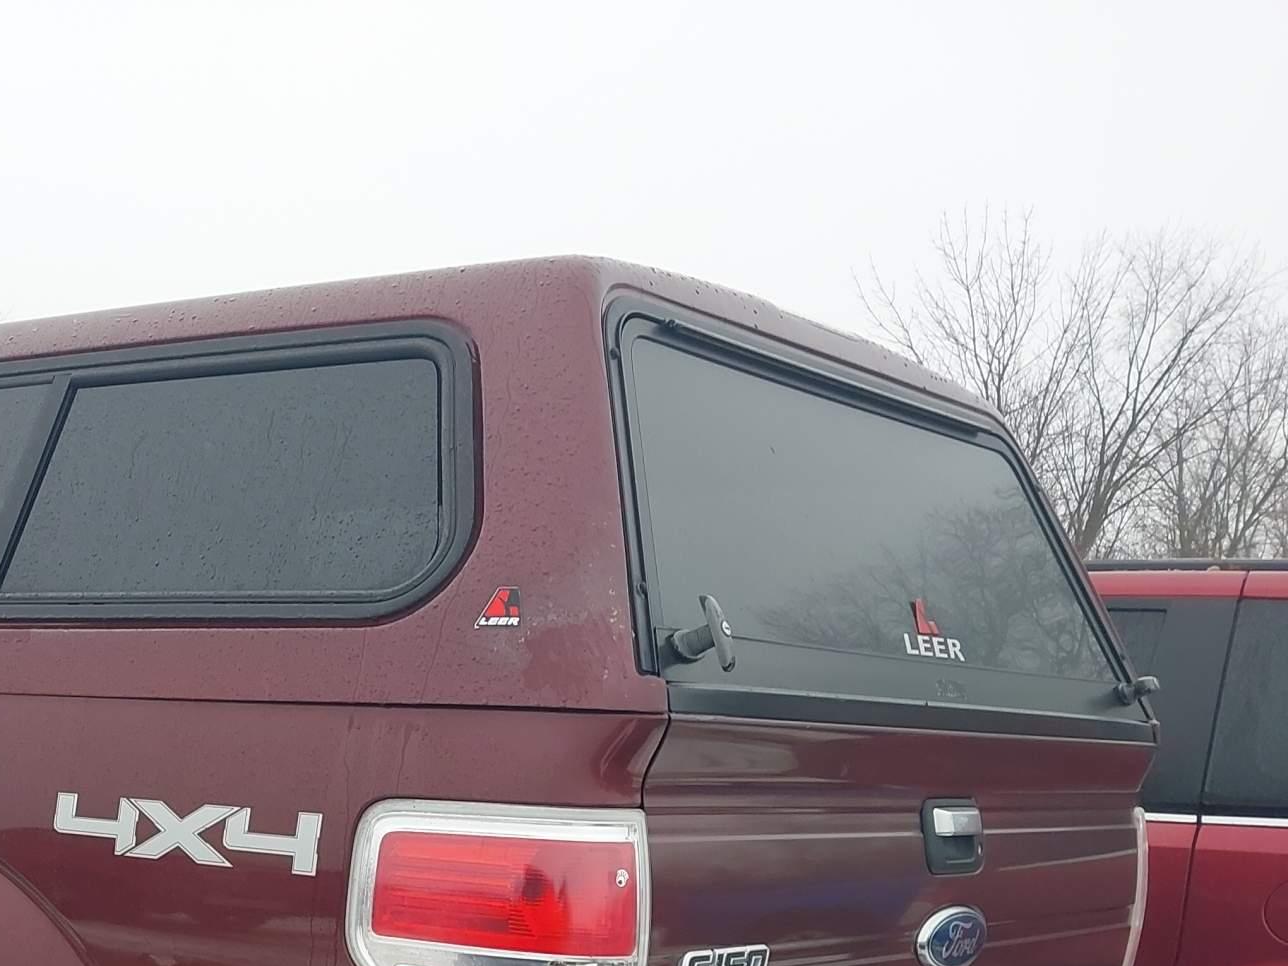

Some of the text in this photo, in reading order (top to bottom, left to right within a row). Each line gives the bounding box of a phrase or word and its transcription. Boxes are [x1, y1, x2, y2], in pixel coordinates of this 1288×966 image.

[478, 616, 520, 626] LEER
[903, 632, 965, 662] LEER
[53, 792, 323, 876] 4X4
[942, 920, 981, 959] Ford
